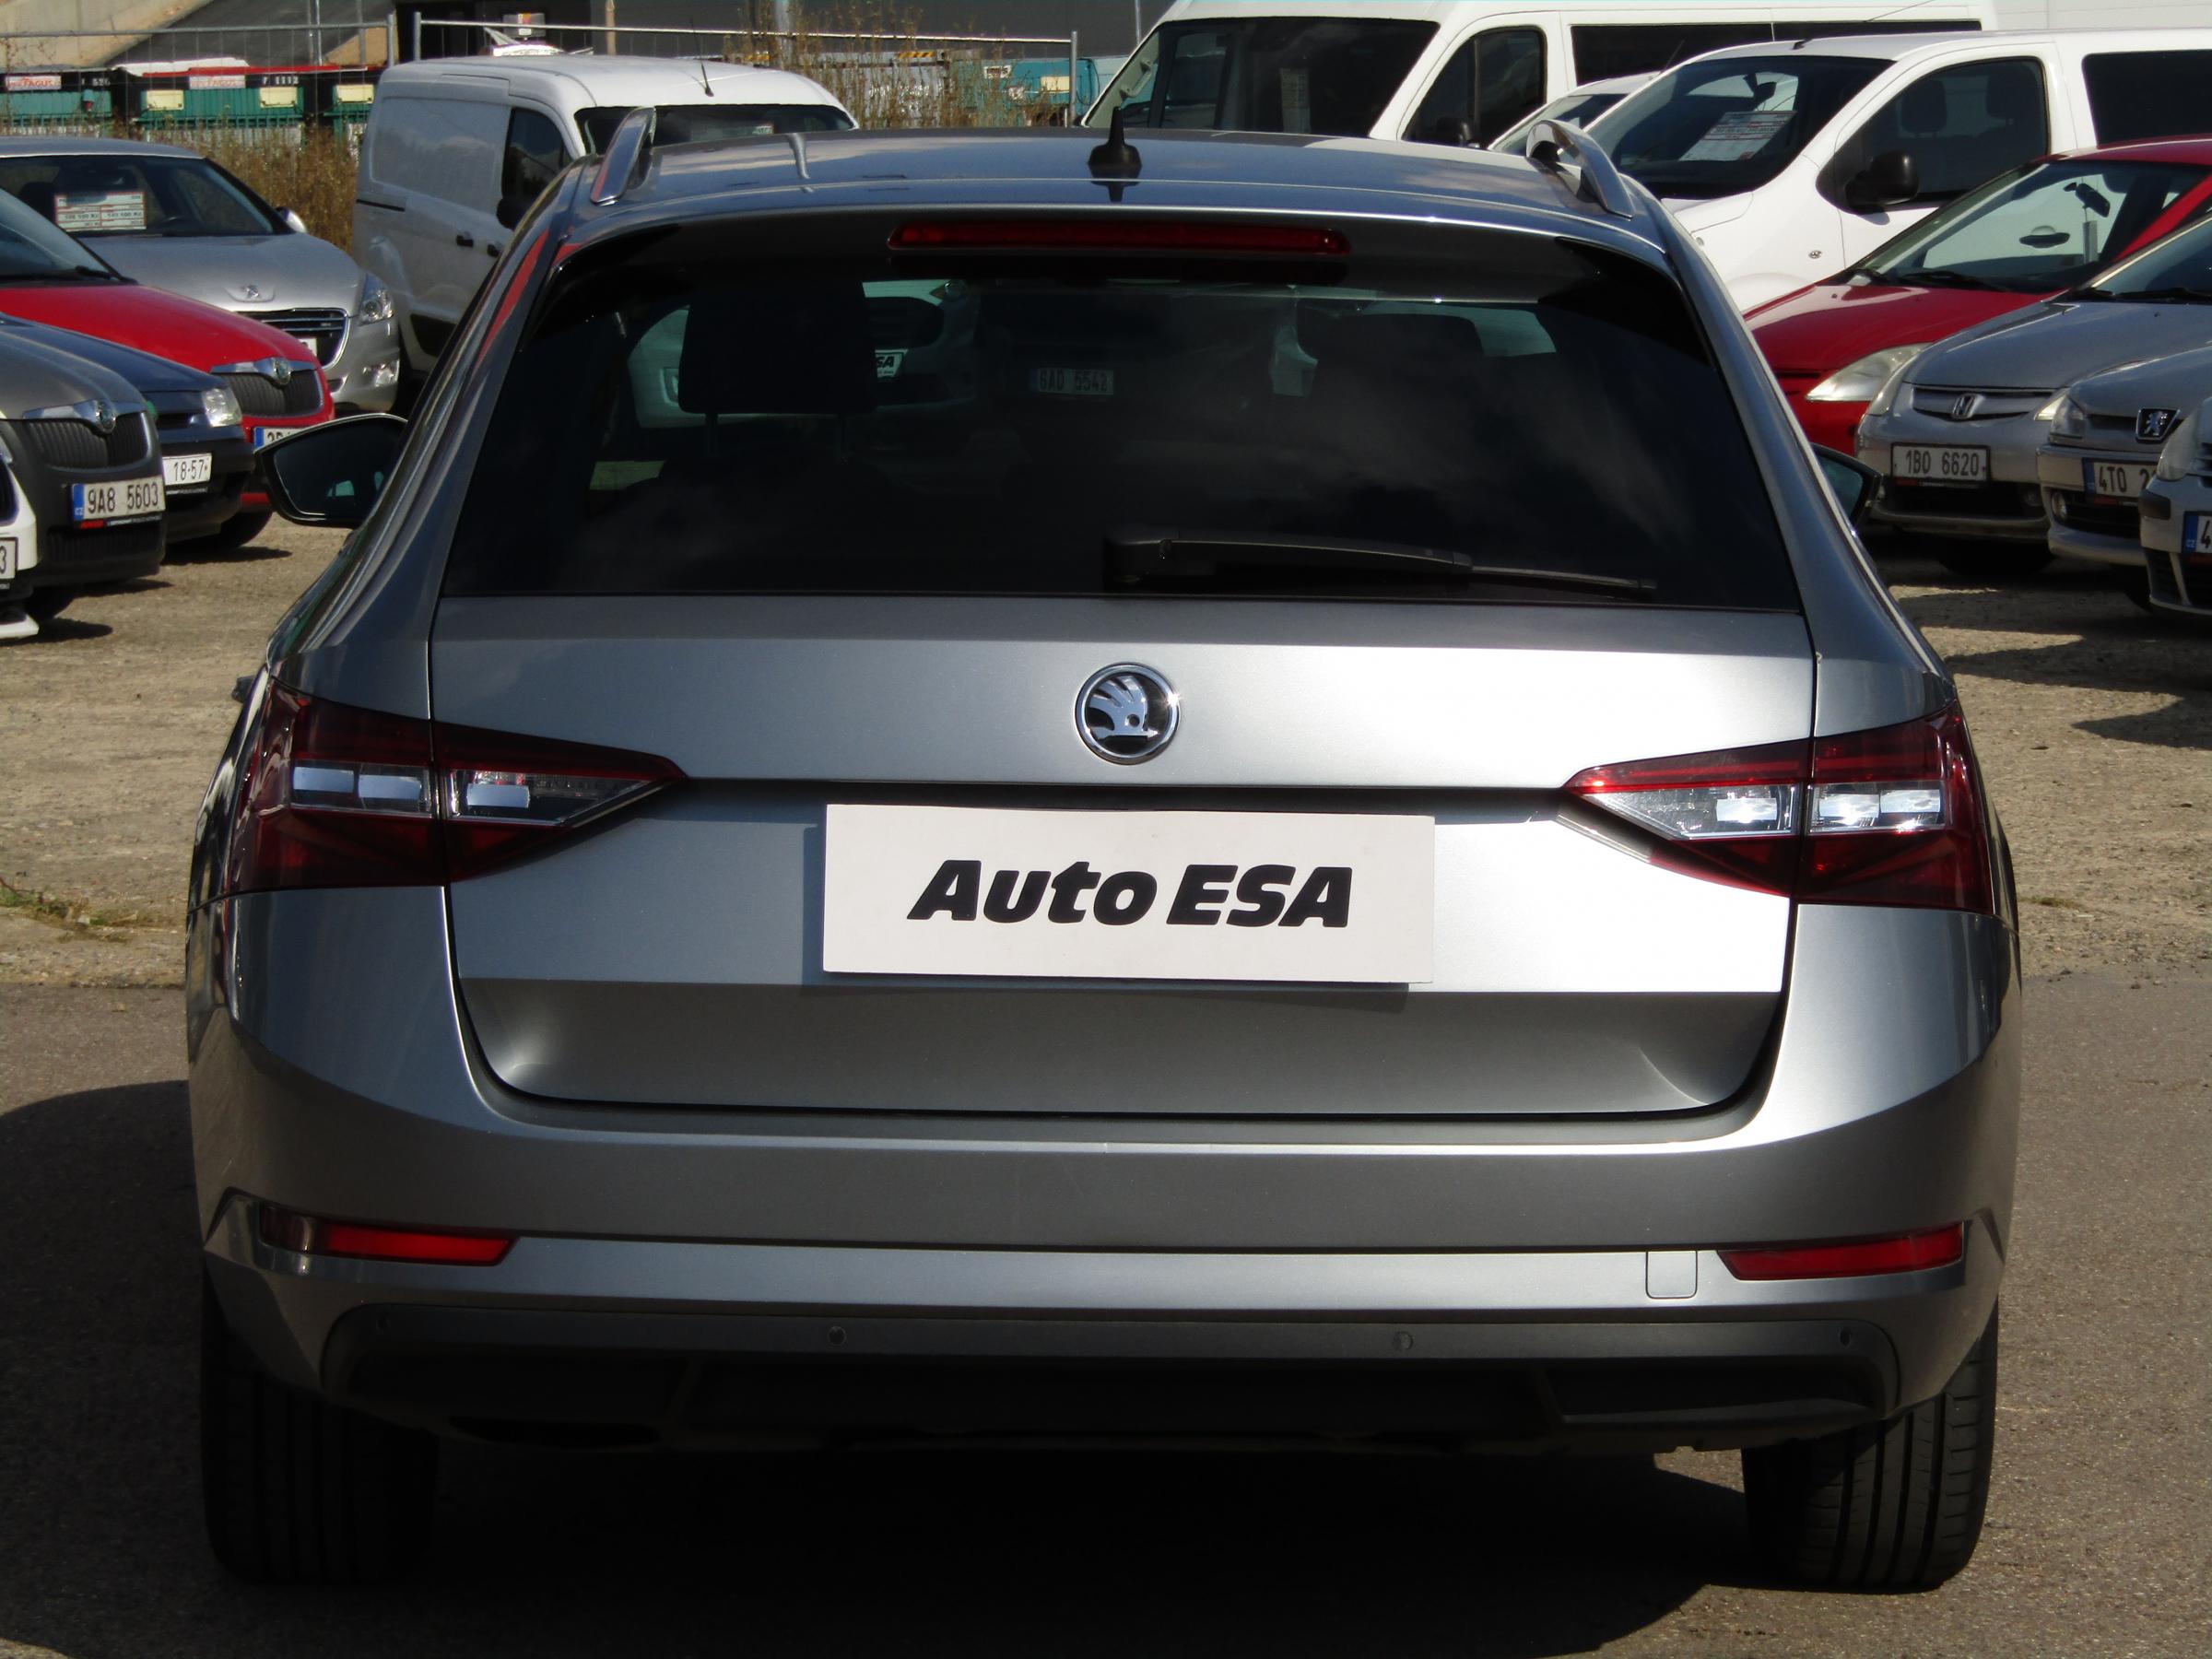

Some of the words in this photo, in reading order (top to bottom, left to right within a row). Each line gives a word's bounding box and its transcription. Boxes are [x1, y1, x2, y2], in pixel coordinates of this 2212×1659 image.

[1940, 451, 1981, 477] 6620
[88, 486, 116, 515] 9A8
[126, 482, 159, 511] 5603
[906, 859, 1158, 926] Auto
[1166, 864, 1354, 929] ESA
